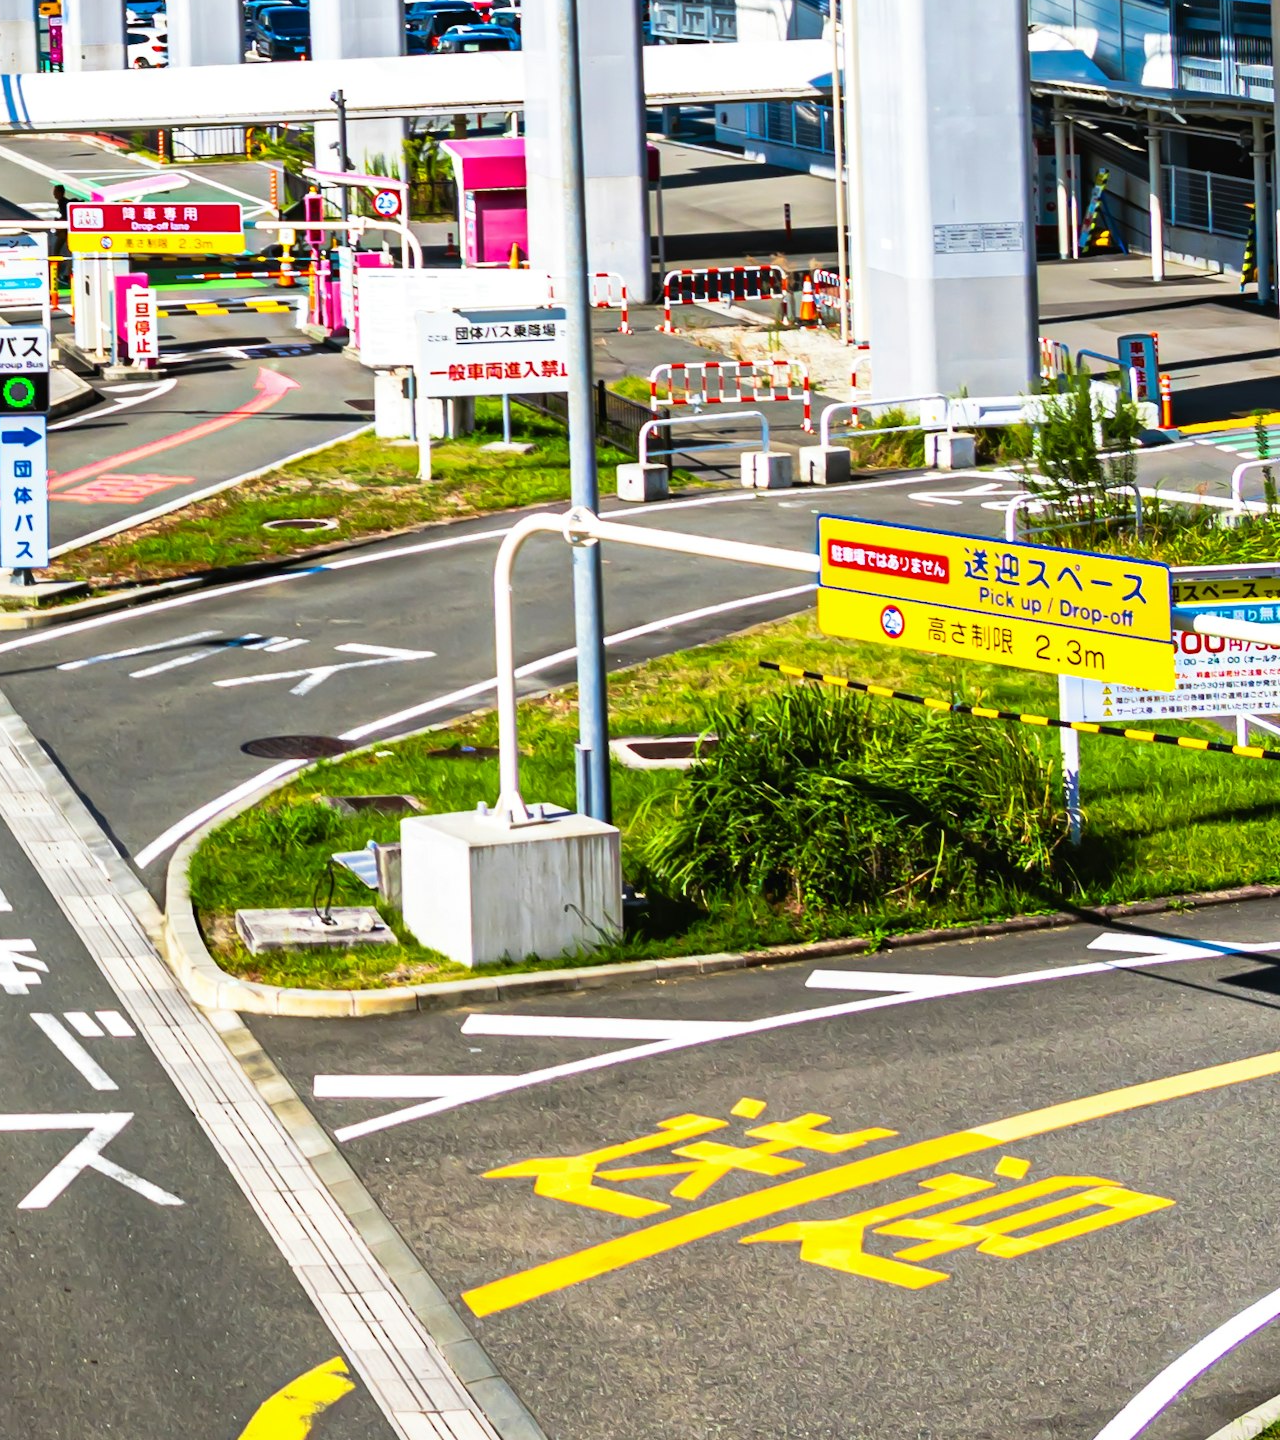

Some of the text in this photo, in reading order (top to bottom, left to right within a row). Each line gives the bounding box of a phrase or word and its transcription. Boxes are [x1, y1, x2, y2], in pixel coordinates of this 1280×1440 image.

[122, 207, 198, 221] 降車専用
[134, 293, 151, 354] 一旦停止
[13, 460, 33, 559] 団体バス
[963, 546, 1148, 605] 送迎スペース
[979, 586, 1016, 609] Pick
[1021, 595, 1042, 616] up
[1059, 599, 1134, 628] Drop-off
[927, 617, 1106, 671] 高さ制限 2.3m
[482, 1096, 1176, 1290] 送迎
